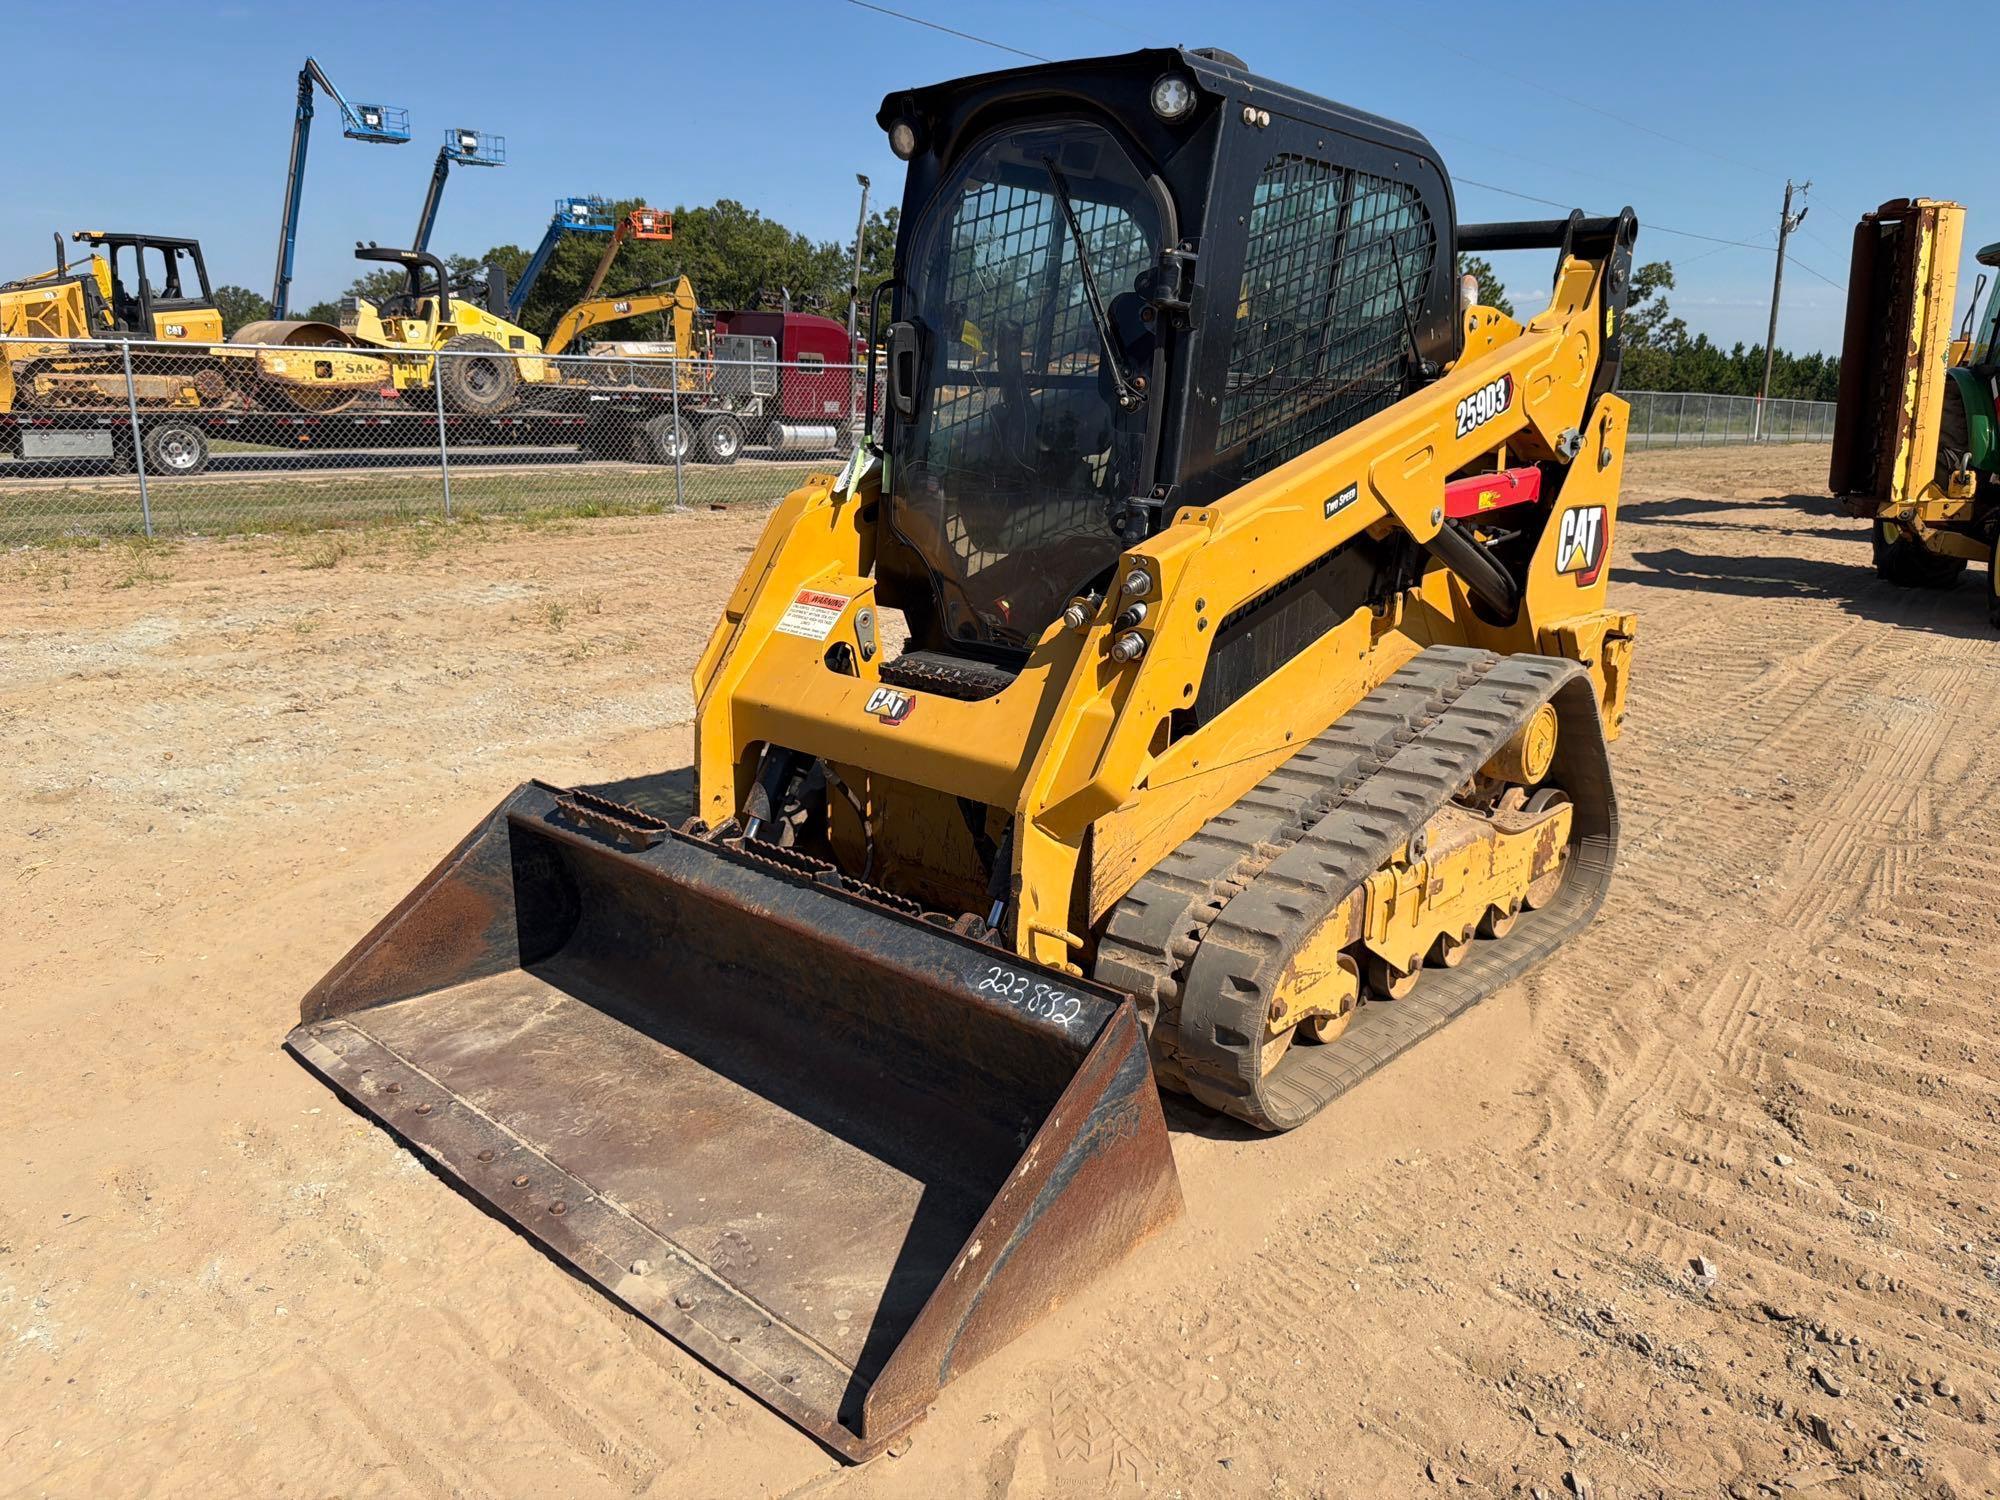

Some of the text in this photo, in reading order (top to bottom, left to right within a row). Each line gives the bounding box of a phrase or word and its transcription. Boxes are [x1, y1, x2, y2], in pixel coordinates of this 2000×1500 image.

[614, 302, 628, 312] CAT
[166, 325, 183, 336] CAT
[1456, 378, 1506, 438] 259D3
[1557, 507, 1602, 573] CAT
[811, 595, 845, 608] WARNING
[865, 688, 906, 718] CAT
